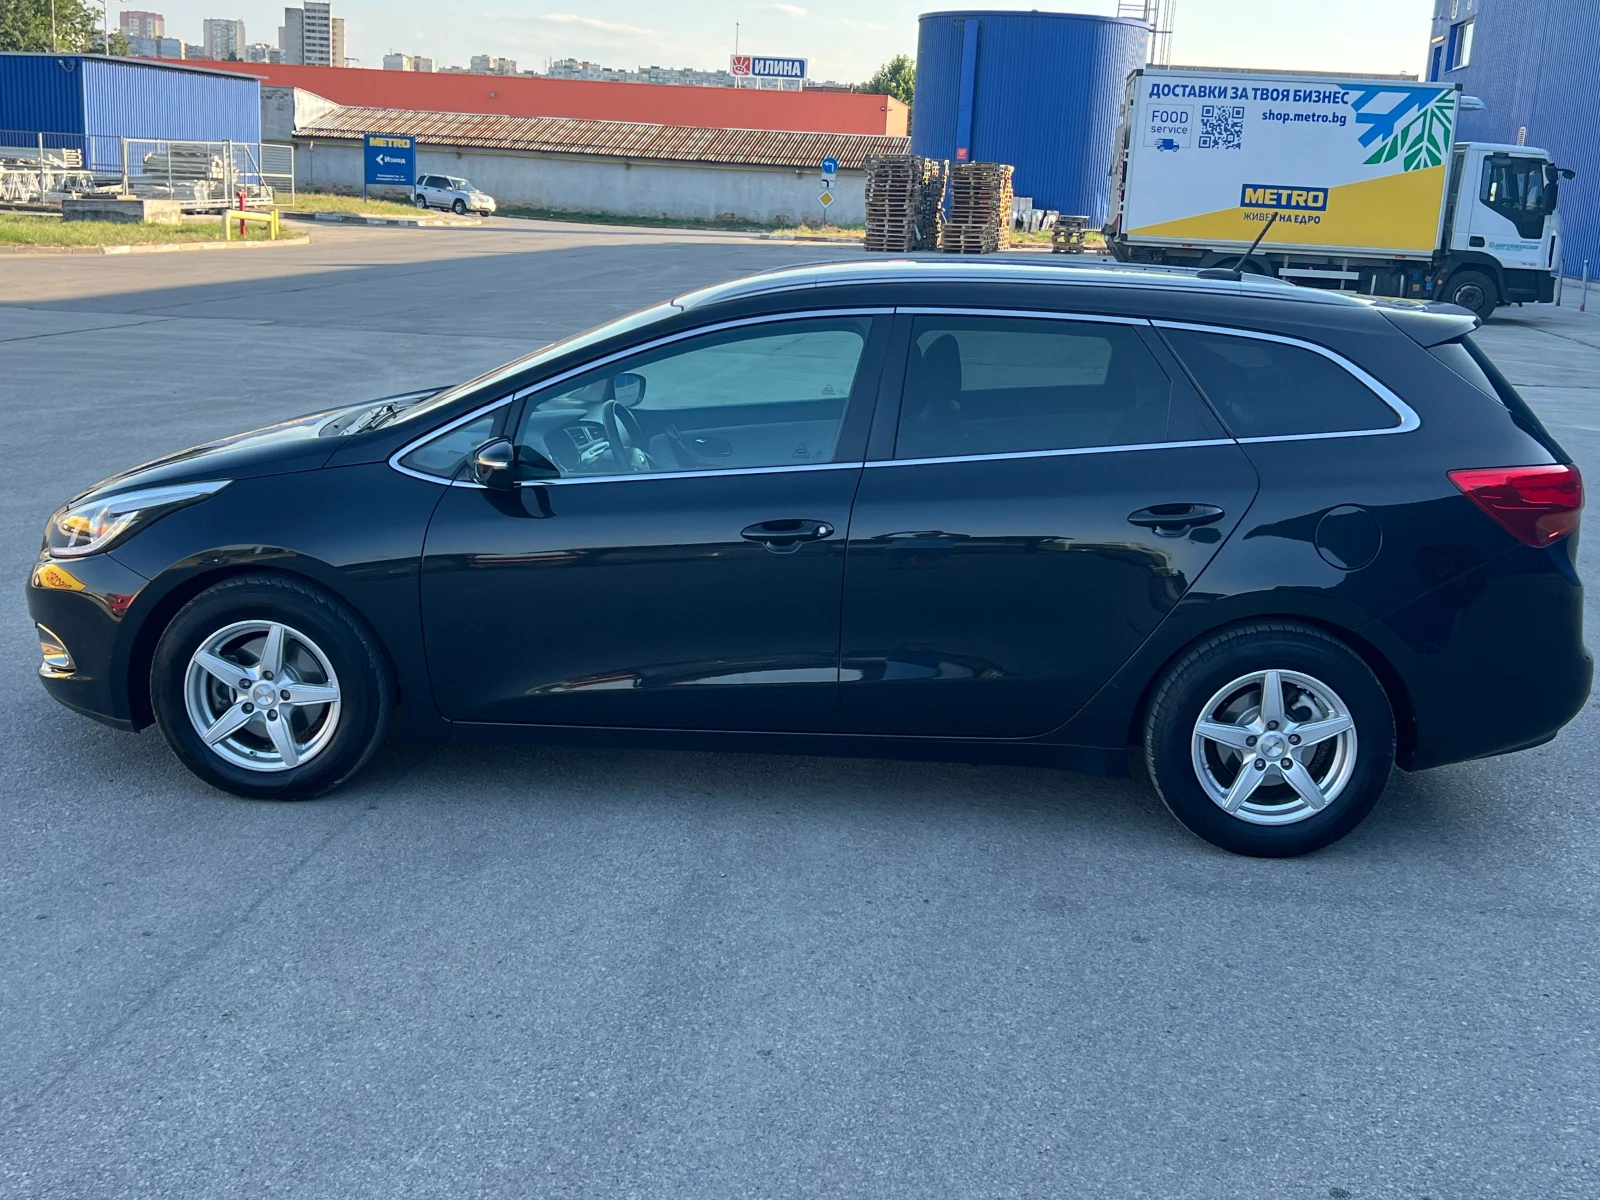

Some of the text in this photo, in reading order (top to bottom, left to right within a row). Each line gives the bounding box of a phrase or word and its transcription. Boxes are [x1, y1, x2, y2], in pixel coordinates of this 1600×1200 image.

[754, 59, 801, 76] ИЛИНА
[1149, 83, 1350, 105] ДОСТАВКИ ЗА ТВОЯ БИЗНЕС
[1151, 110, 1189, 124] FOOD
[1261, 109, 1347, 127] shop.metro.bg
[1150, 125, 1188, 135] service
[369, 137, 411, 149] METRO
[1244, 187, 1325, 207] METRO
[1279, 214, 1292, 223] НА
[1294, 215, 1321, 225] ЕДРО
